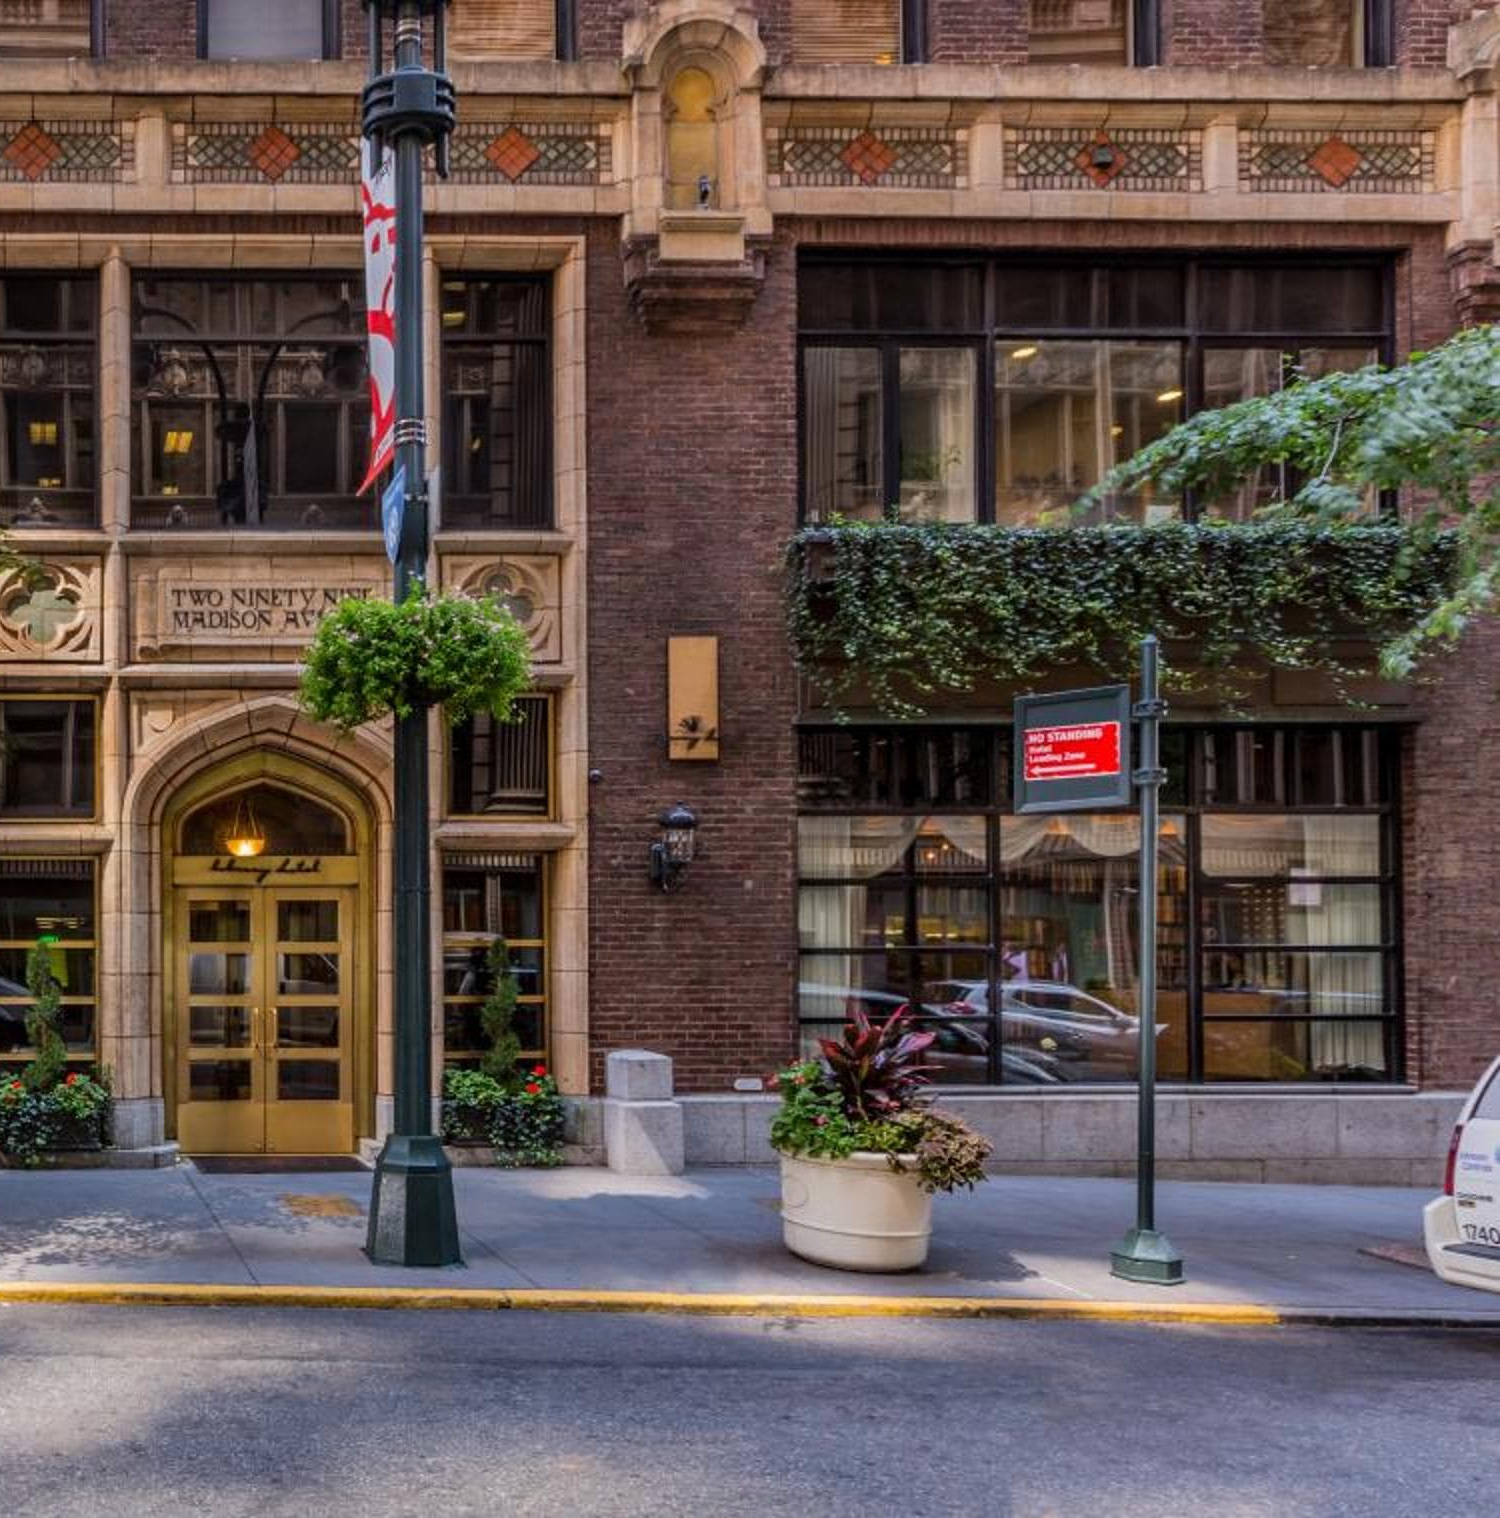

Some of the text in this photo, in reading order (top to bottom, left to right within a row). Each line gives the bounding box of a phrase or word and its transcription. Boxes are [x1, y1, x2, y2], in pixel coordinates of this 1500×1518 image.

[171, 588, 223, 607] TWO
[230, 587, 315, 610] NINETY
[172, 610, 274, 632] MADISON
[1027, 727, 1104, 744] NO STANDING
